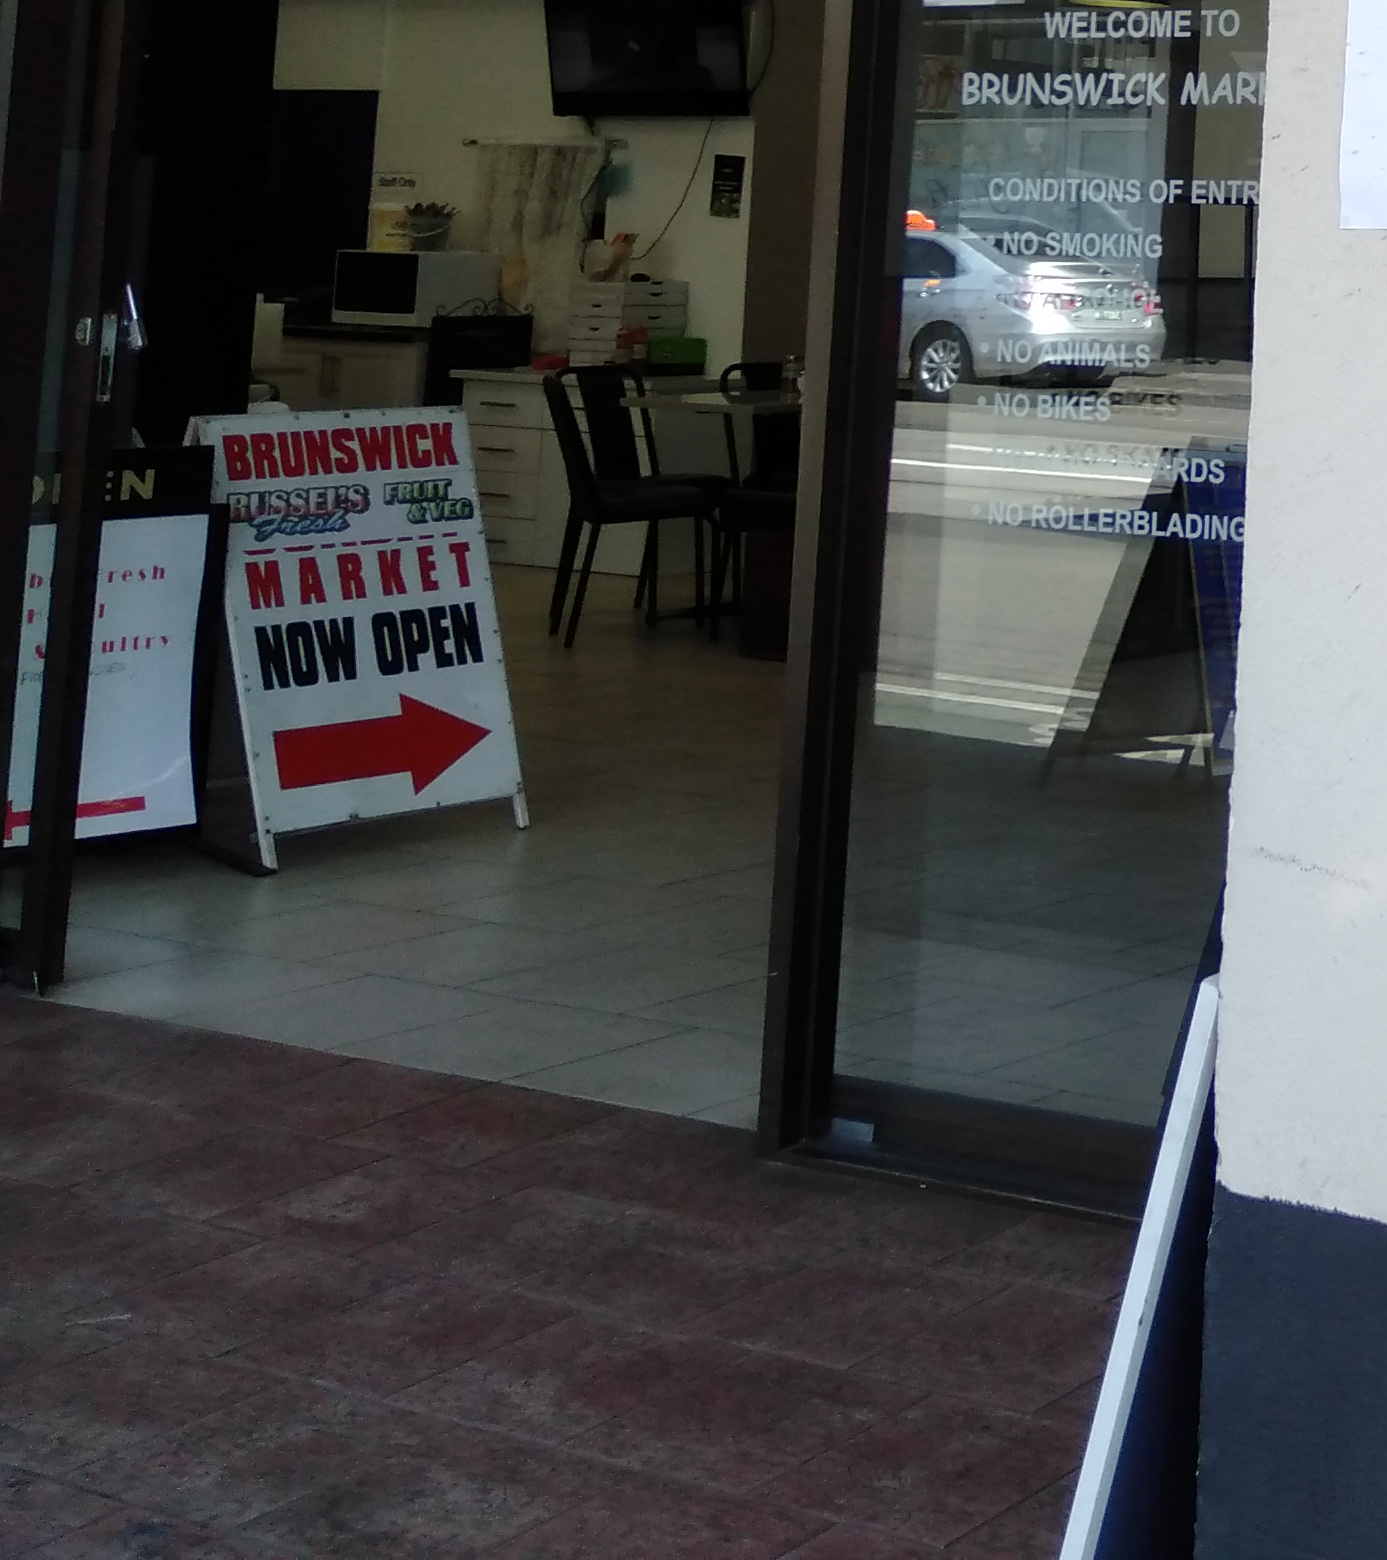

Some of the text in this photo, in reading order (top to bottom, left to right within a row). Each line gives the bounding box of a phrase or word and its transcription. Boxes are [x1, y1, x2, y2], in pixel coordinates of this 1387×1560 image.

[1044, 8, 1241, 39] WELCOME TO
[961, 71, 1167, 107] BRUNSWICK
[988, 177, 1142, 204] CONDITIONS
[1148, 179, 1184, 204] OF
[1001, 231, 1163, 259] NO SMOKING
[996, 339, 1151, 369] NO ANIMALS
[993, 392, 1031, 417] NO
[1037, 394, 1112, 422] BIKES
[222, 422, 460, 481] BRUNSWICK
[383, 478, 453, 506] FRUIT
[987, 501, 1246, 542] NO ROLLERBLADING
[245, 541, 471, 611] MARKET
[254, 601, 485, 691] NOW OPEN
